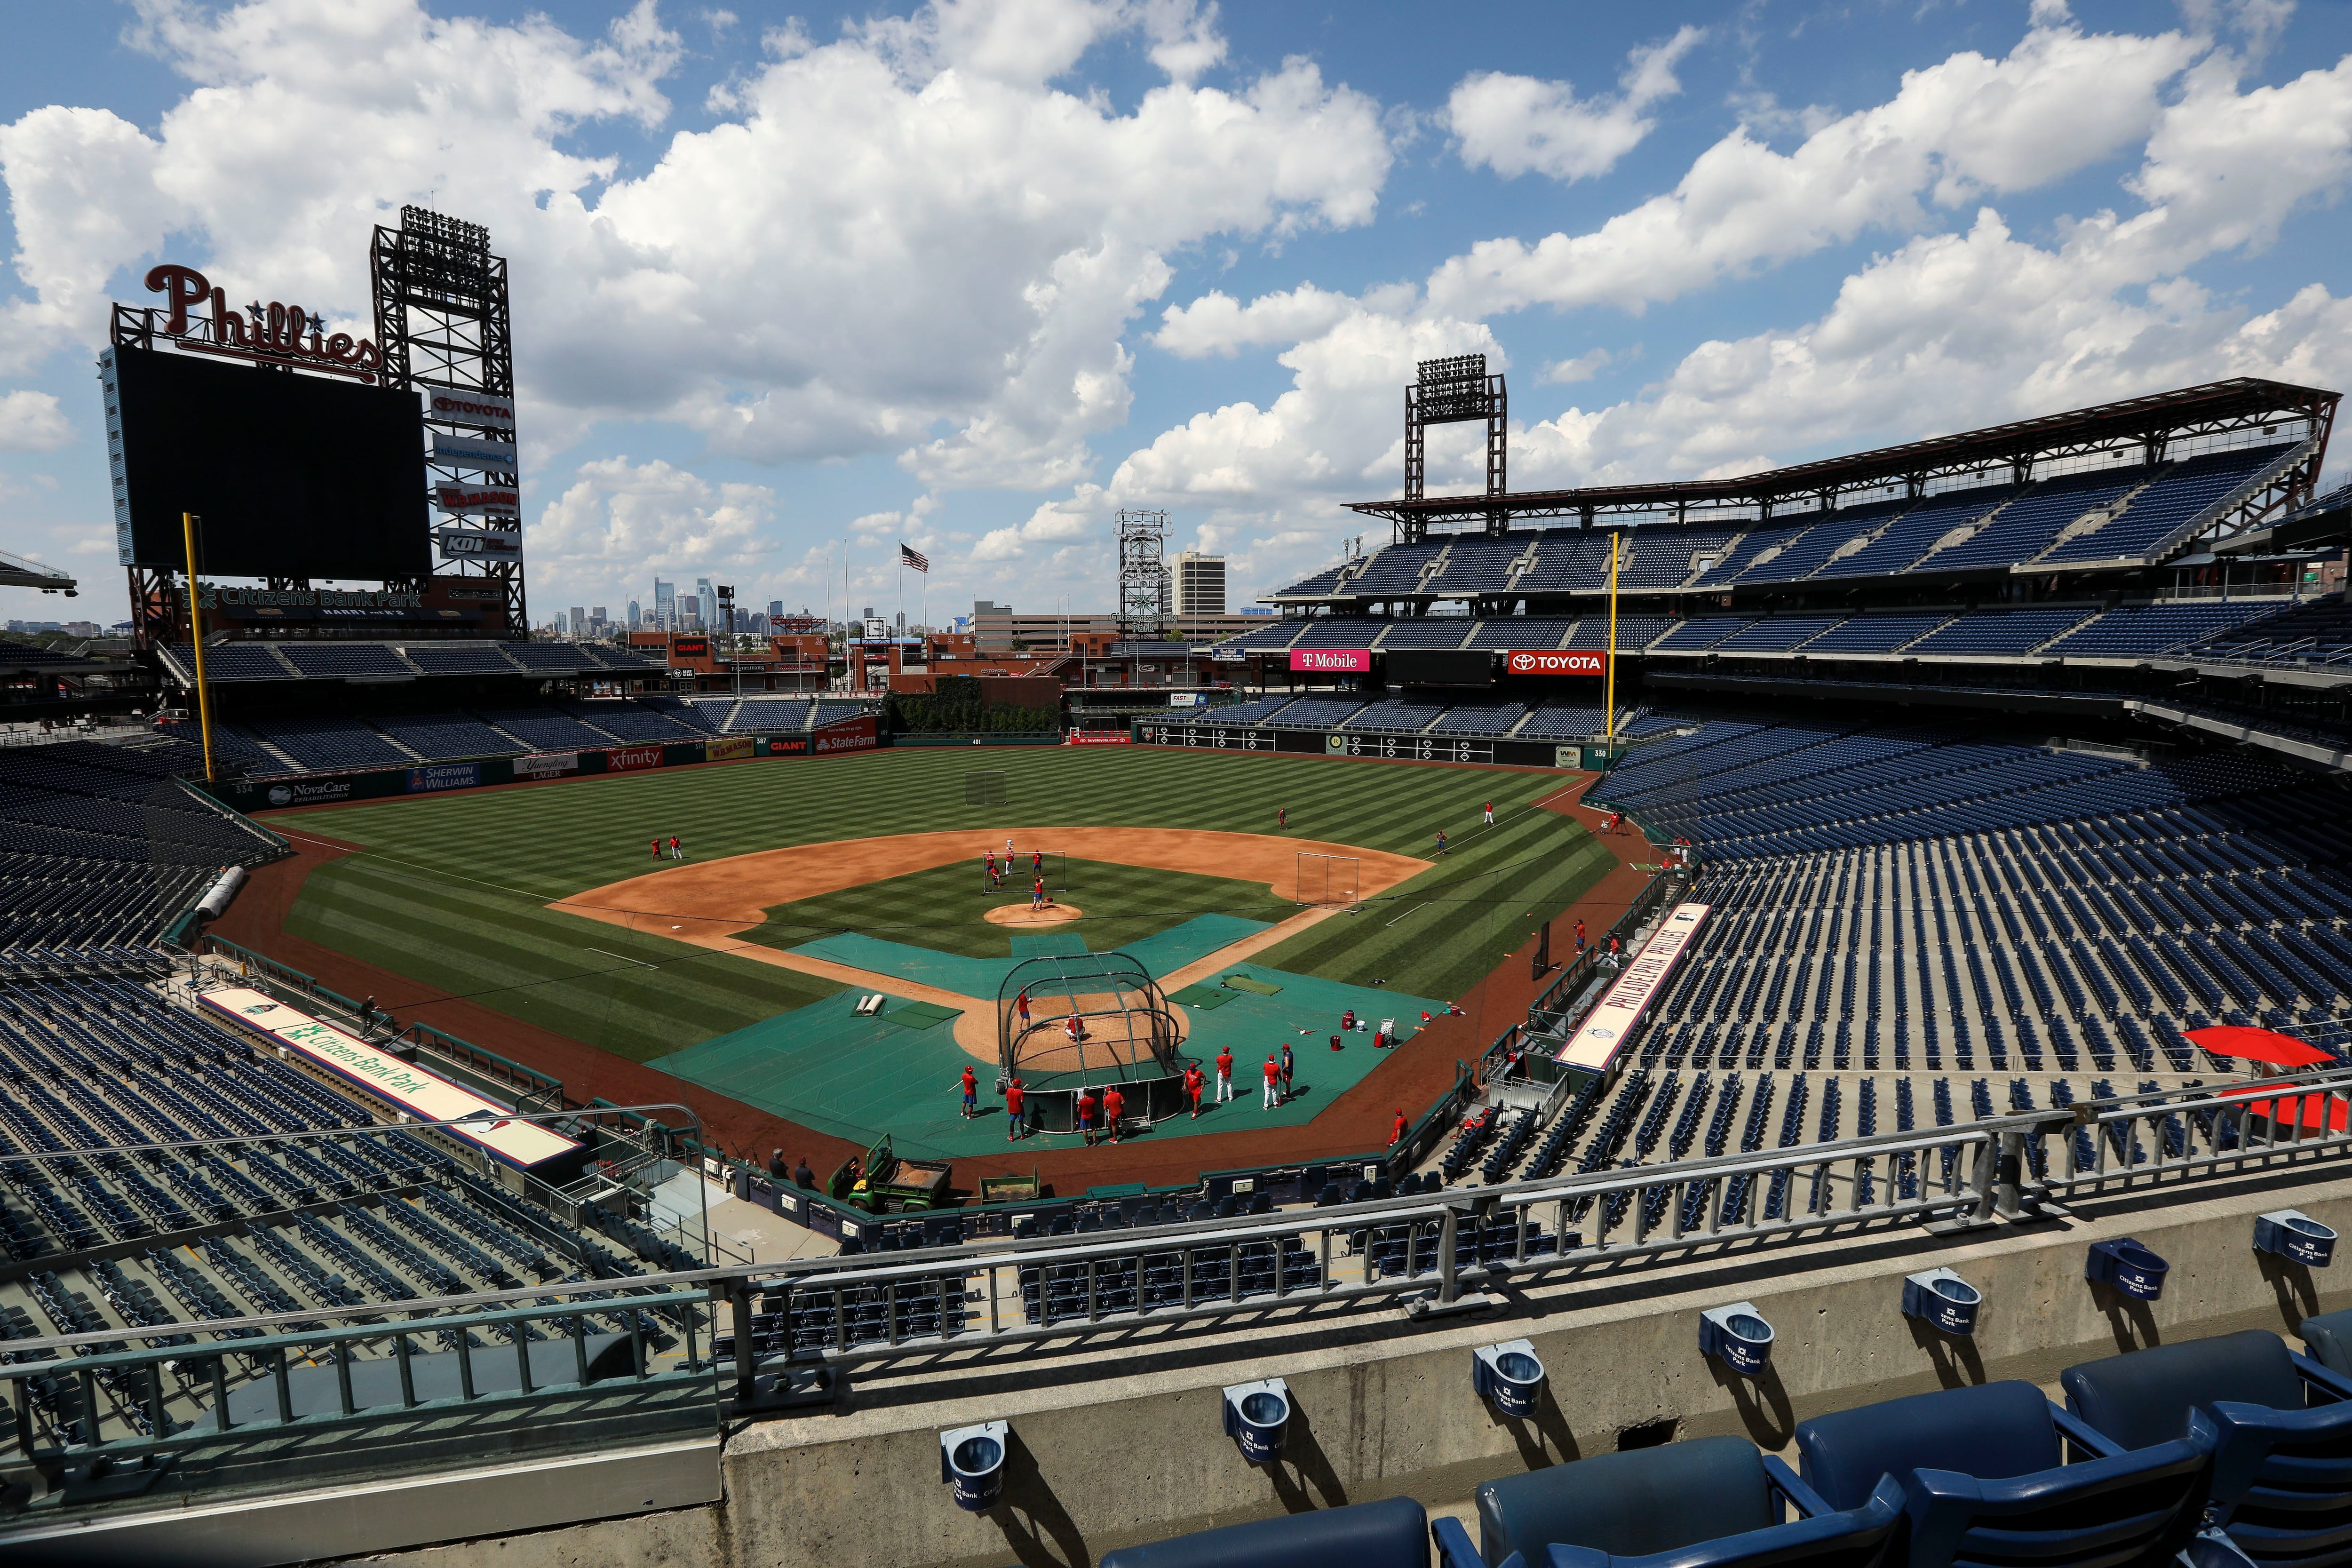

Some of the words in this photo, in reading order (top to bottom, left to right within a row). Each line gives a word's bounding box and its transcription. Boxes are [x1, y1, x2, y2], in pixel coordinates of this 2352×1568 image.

[144, 264, 383, 369] Phillies
[453, 400, 511, 419] TOYOTA
[436, 446, 502, 461] Independence
[446, 536, 484, 552] KDI
[222, 587, 316, 605] Citizens
[320, 589, 374, 606] Bank
[377, 590, 422, 607] Park
[1110, 612, 1149, 621] Citizens
[1152, 612, 1176, 621] Bank
[1133, 622, 1154, 633] Park
[1303, 653, 1313, 667] T
[1315, 653, 1357, 667] Mobile
[1537, 656, 1601, 669] TOYOTA
[771, 741, 806, 750] GIANT
[522, 756, 570, 772] Yuengling
[612, 750, 660, 769] xfinity
[426, 766, 473, 779] SHERWIN
[533, 770, 561, 780] LAGER
[236, 785, 253, 794] 334
[292, 782, 350, 796] NovaCare
[294, 792, 349, 803] REHABILITATION
[1605, 958, 1668, 1010] PHILADELPHIA
[1647, 930, 1688, 956] PHILLIES
[308, 1036, 364, 1062] Citizens
[352, 1057, 400, 1078] Bank
[383, 1073, 430, 1094] Park
[2289, 1242, 2313, 1256] Citizens
[2119, 1275, 2143, 1289] Citizens
[2129, 1285, 2144, 1294] Park
[1941, 1318, 1956, 1327] Park
[1725, 1344, 1745, 1361] Citizens
[1732, 1357, 1746, 1367] Park
[1501, 1397, 1512, 1408] Park
[1243, 1441, 1254, 1453] Park
[962, 1490, 978, 1498] Bank
